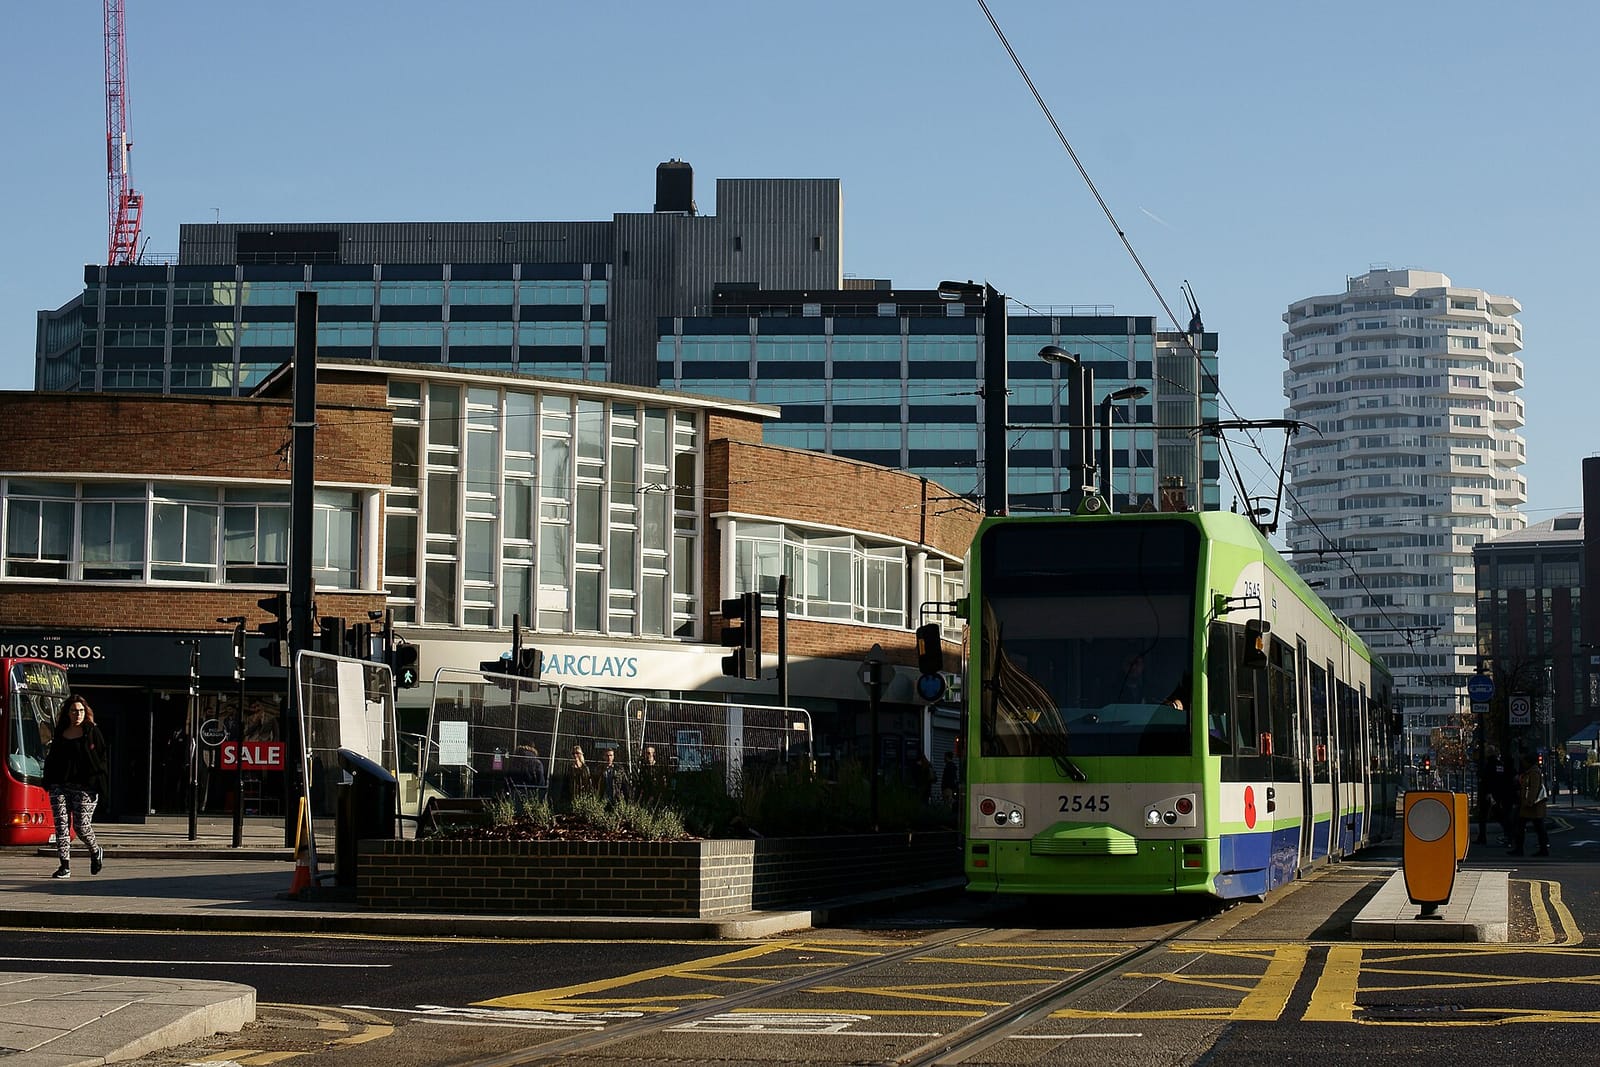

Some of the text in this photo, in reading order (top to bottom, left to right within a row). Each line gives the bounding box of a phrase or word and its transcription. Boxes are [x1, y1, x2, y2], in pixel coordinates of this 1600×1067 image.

[1245, 581, 1261, 597] 2545
[0, 644, 106, 660] MOSS BROS.
[1513, 703, 1526, 711] 20
[223, 745, 280, 765] SALE
[1058, 795, 1110, 812] 2545
